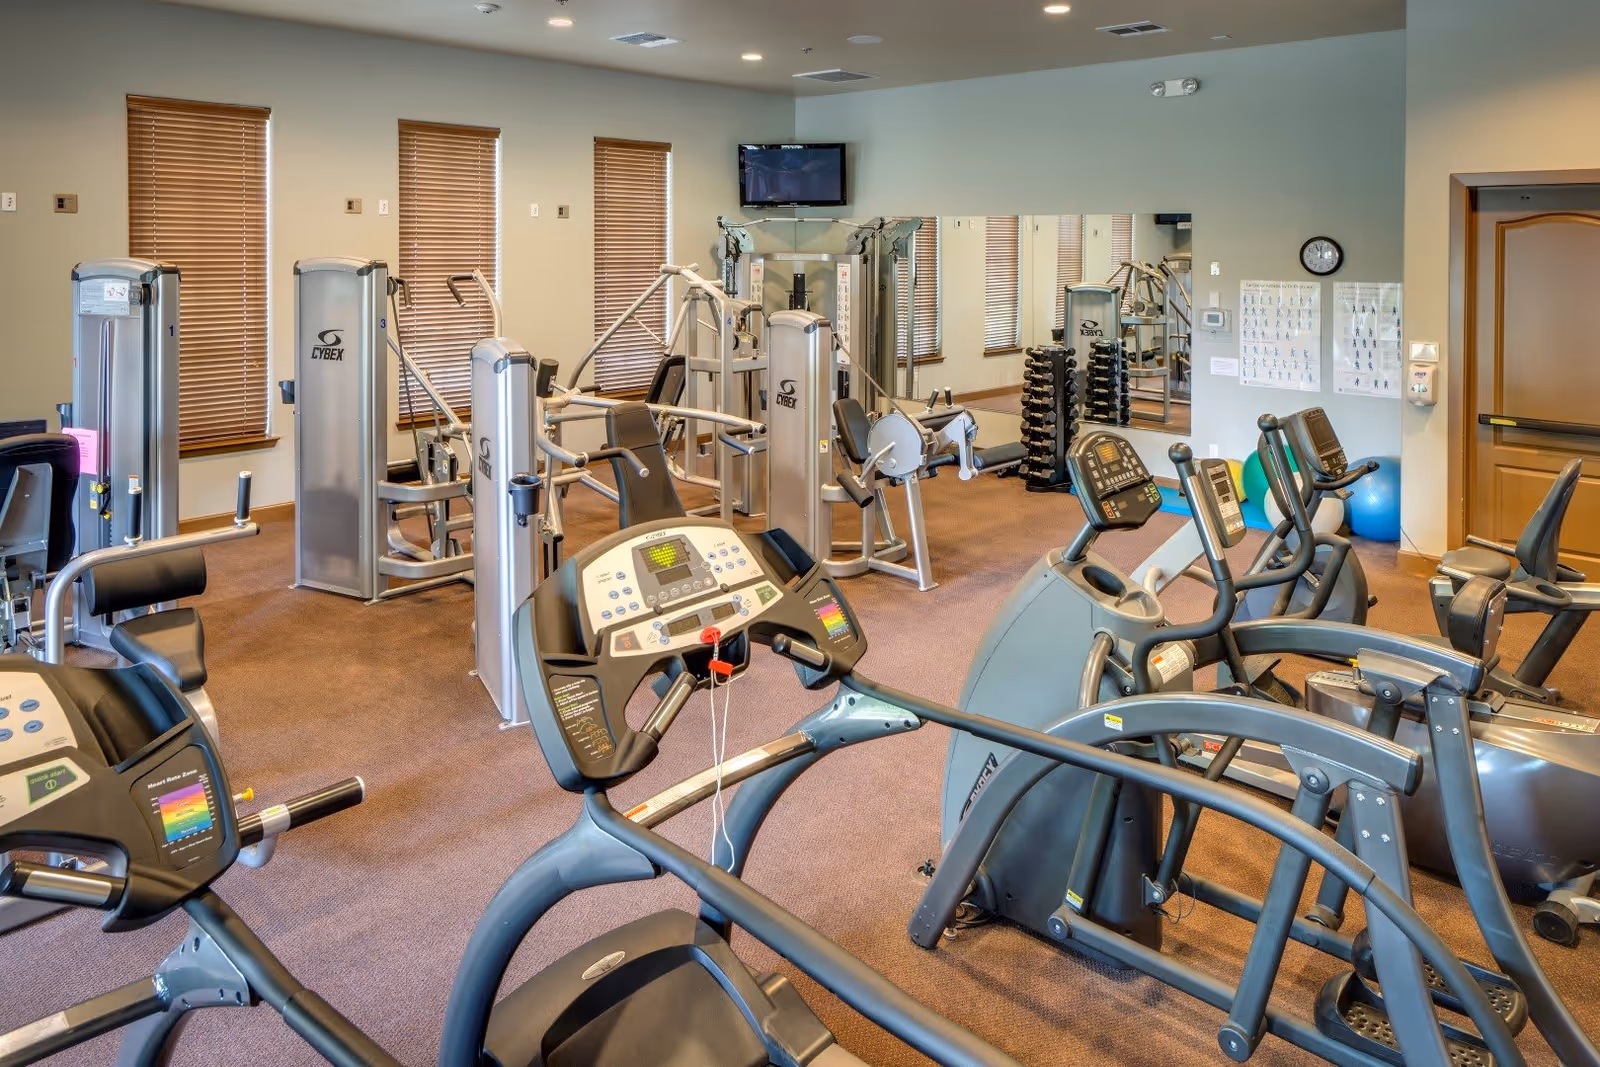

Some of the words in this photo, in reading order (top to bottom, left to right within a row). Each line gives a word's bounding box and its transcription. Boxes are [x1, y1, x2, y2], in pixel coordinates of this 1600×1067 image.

[168, 325, 174, 337] 1
[380, 318, 386, 329] 3
[311, 346, 345, 361] CYBEX
[776, 393, 798, 410] CYBEX
[147, 779, 166, 789] Heart
[166, 774, 181, 783] Rate
[182, 769, 198, 778] Zone
